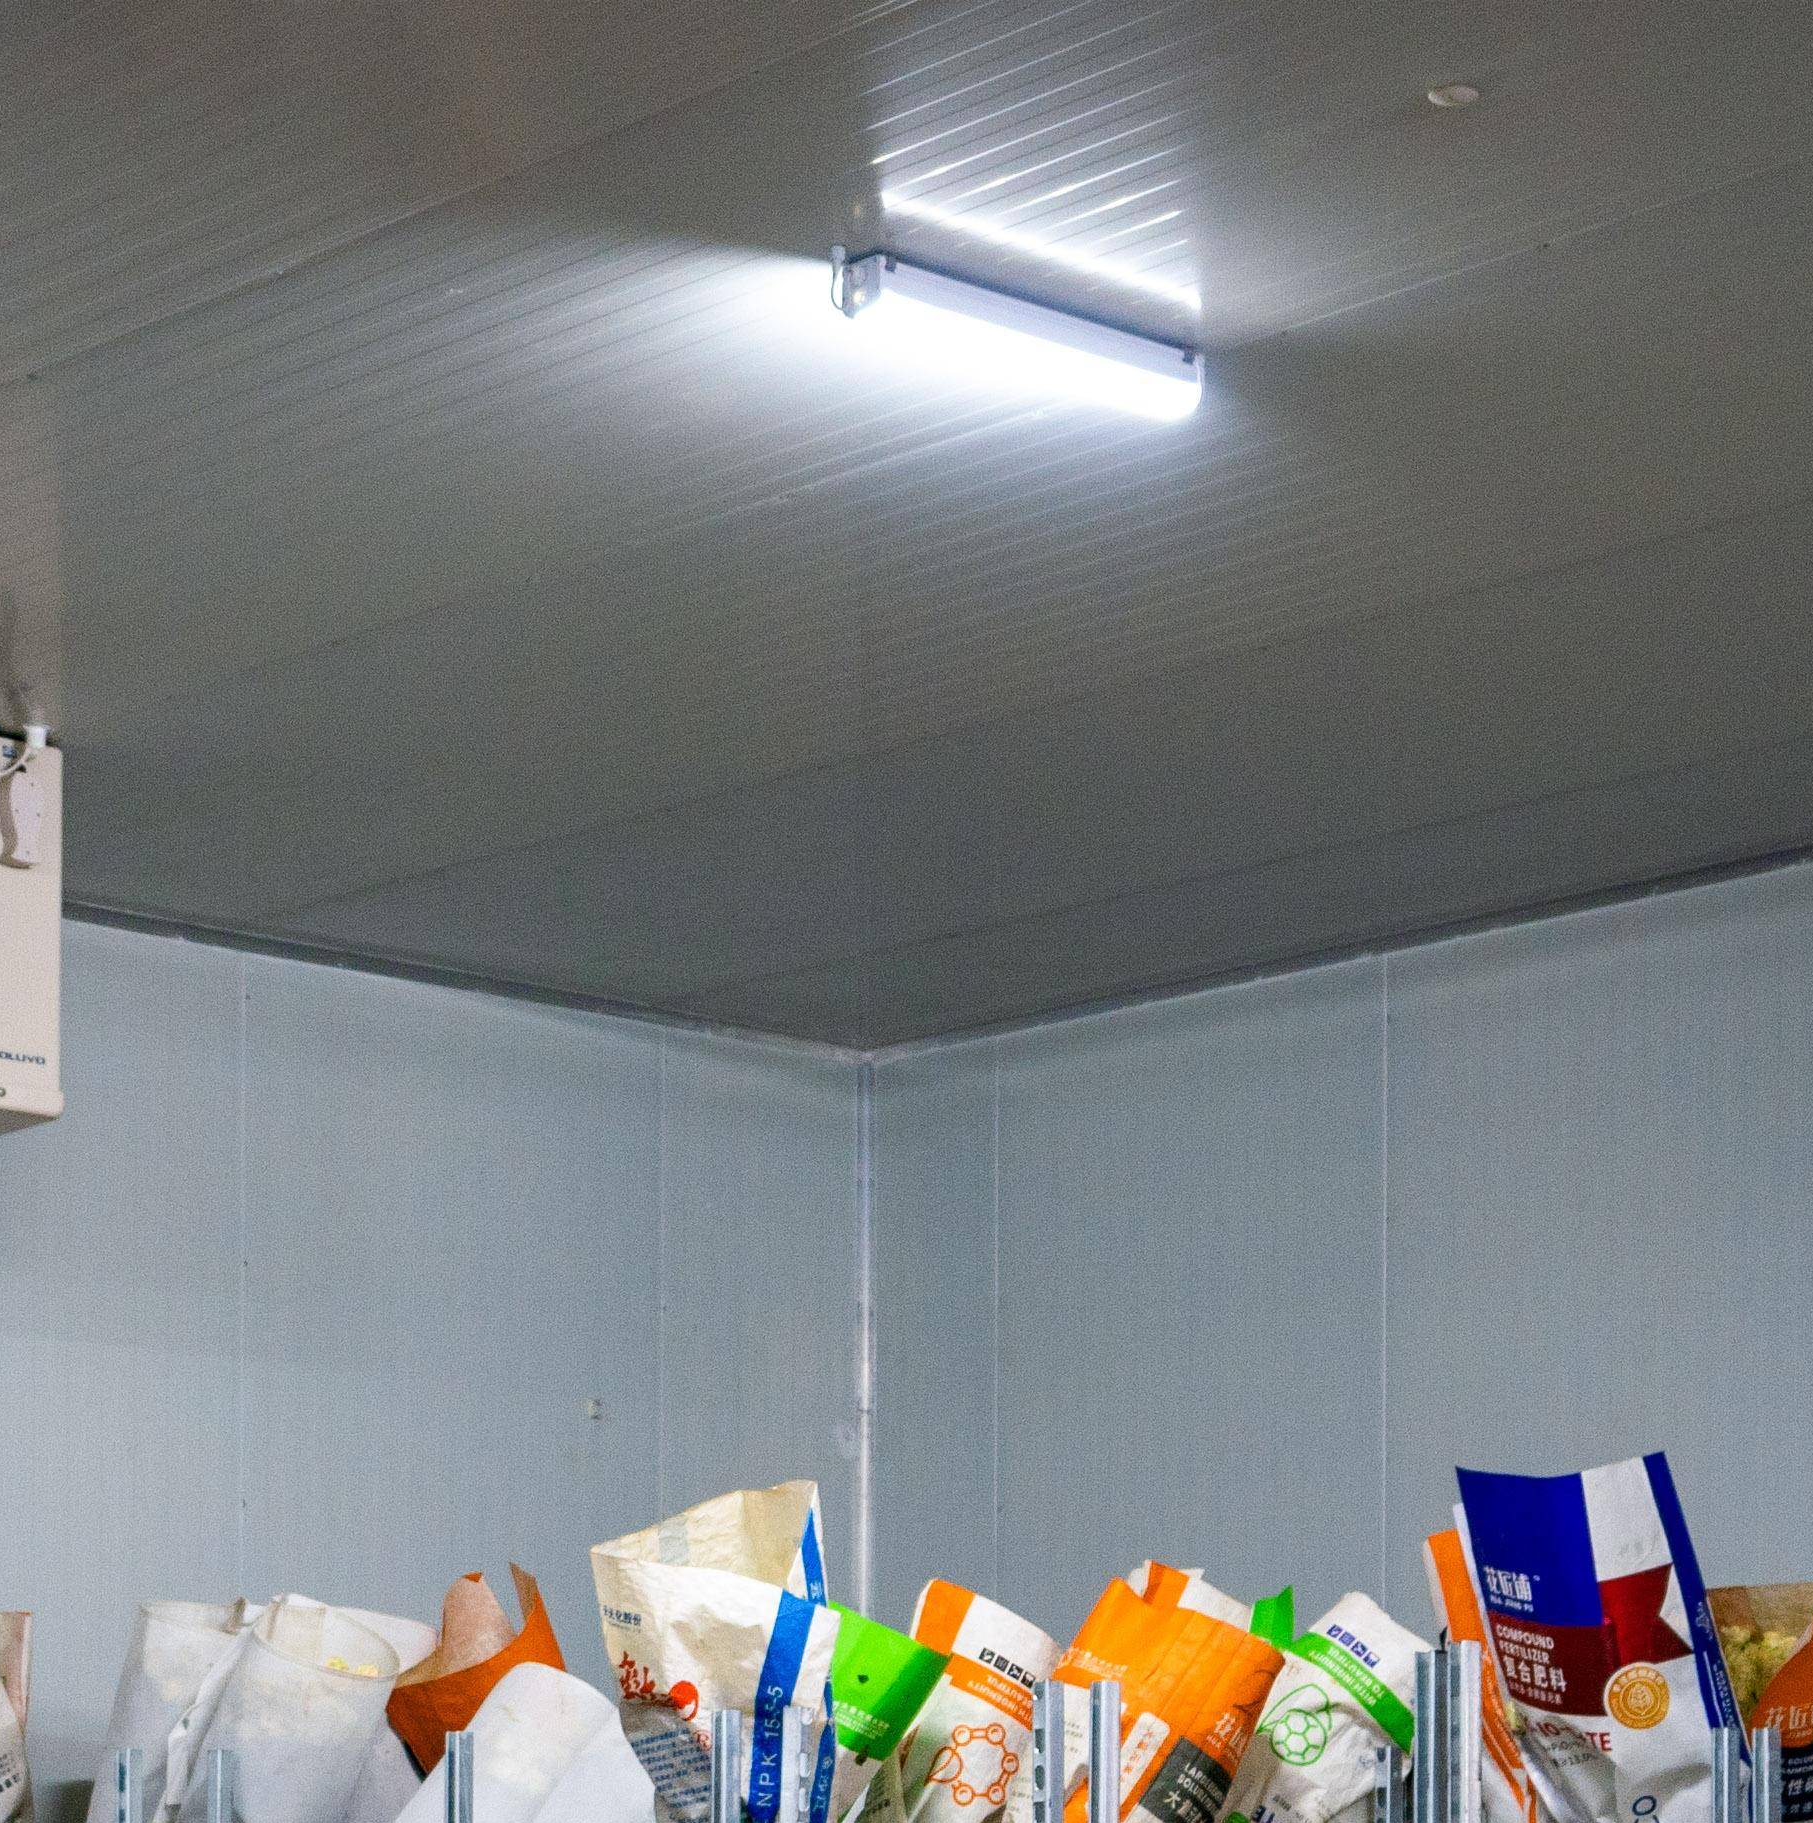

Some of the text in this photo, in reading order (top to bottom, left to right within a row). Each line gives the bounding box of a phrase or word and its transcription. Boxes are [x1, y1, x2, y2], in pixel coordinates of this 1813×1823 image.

[1496, 1624, 1555, 1651] COMPOUND
[1503, 1656, 1568, 1692] 复合肥料
